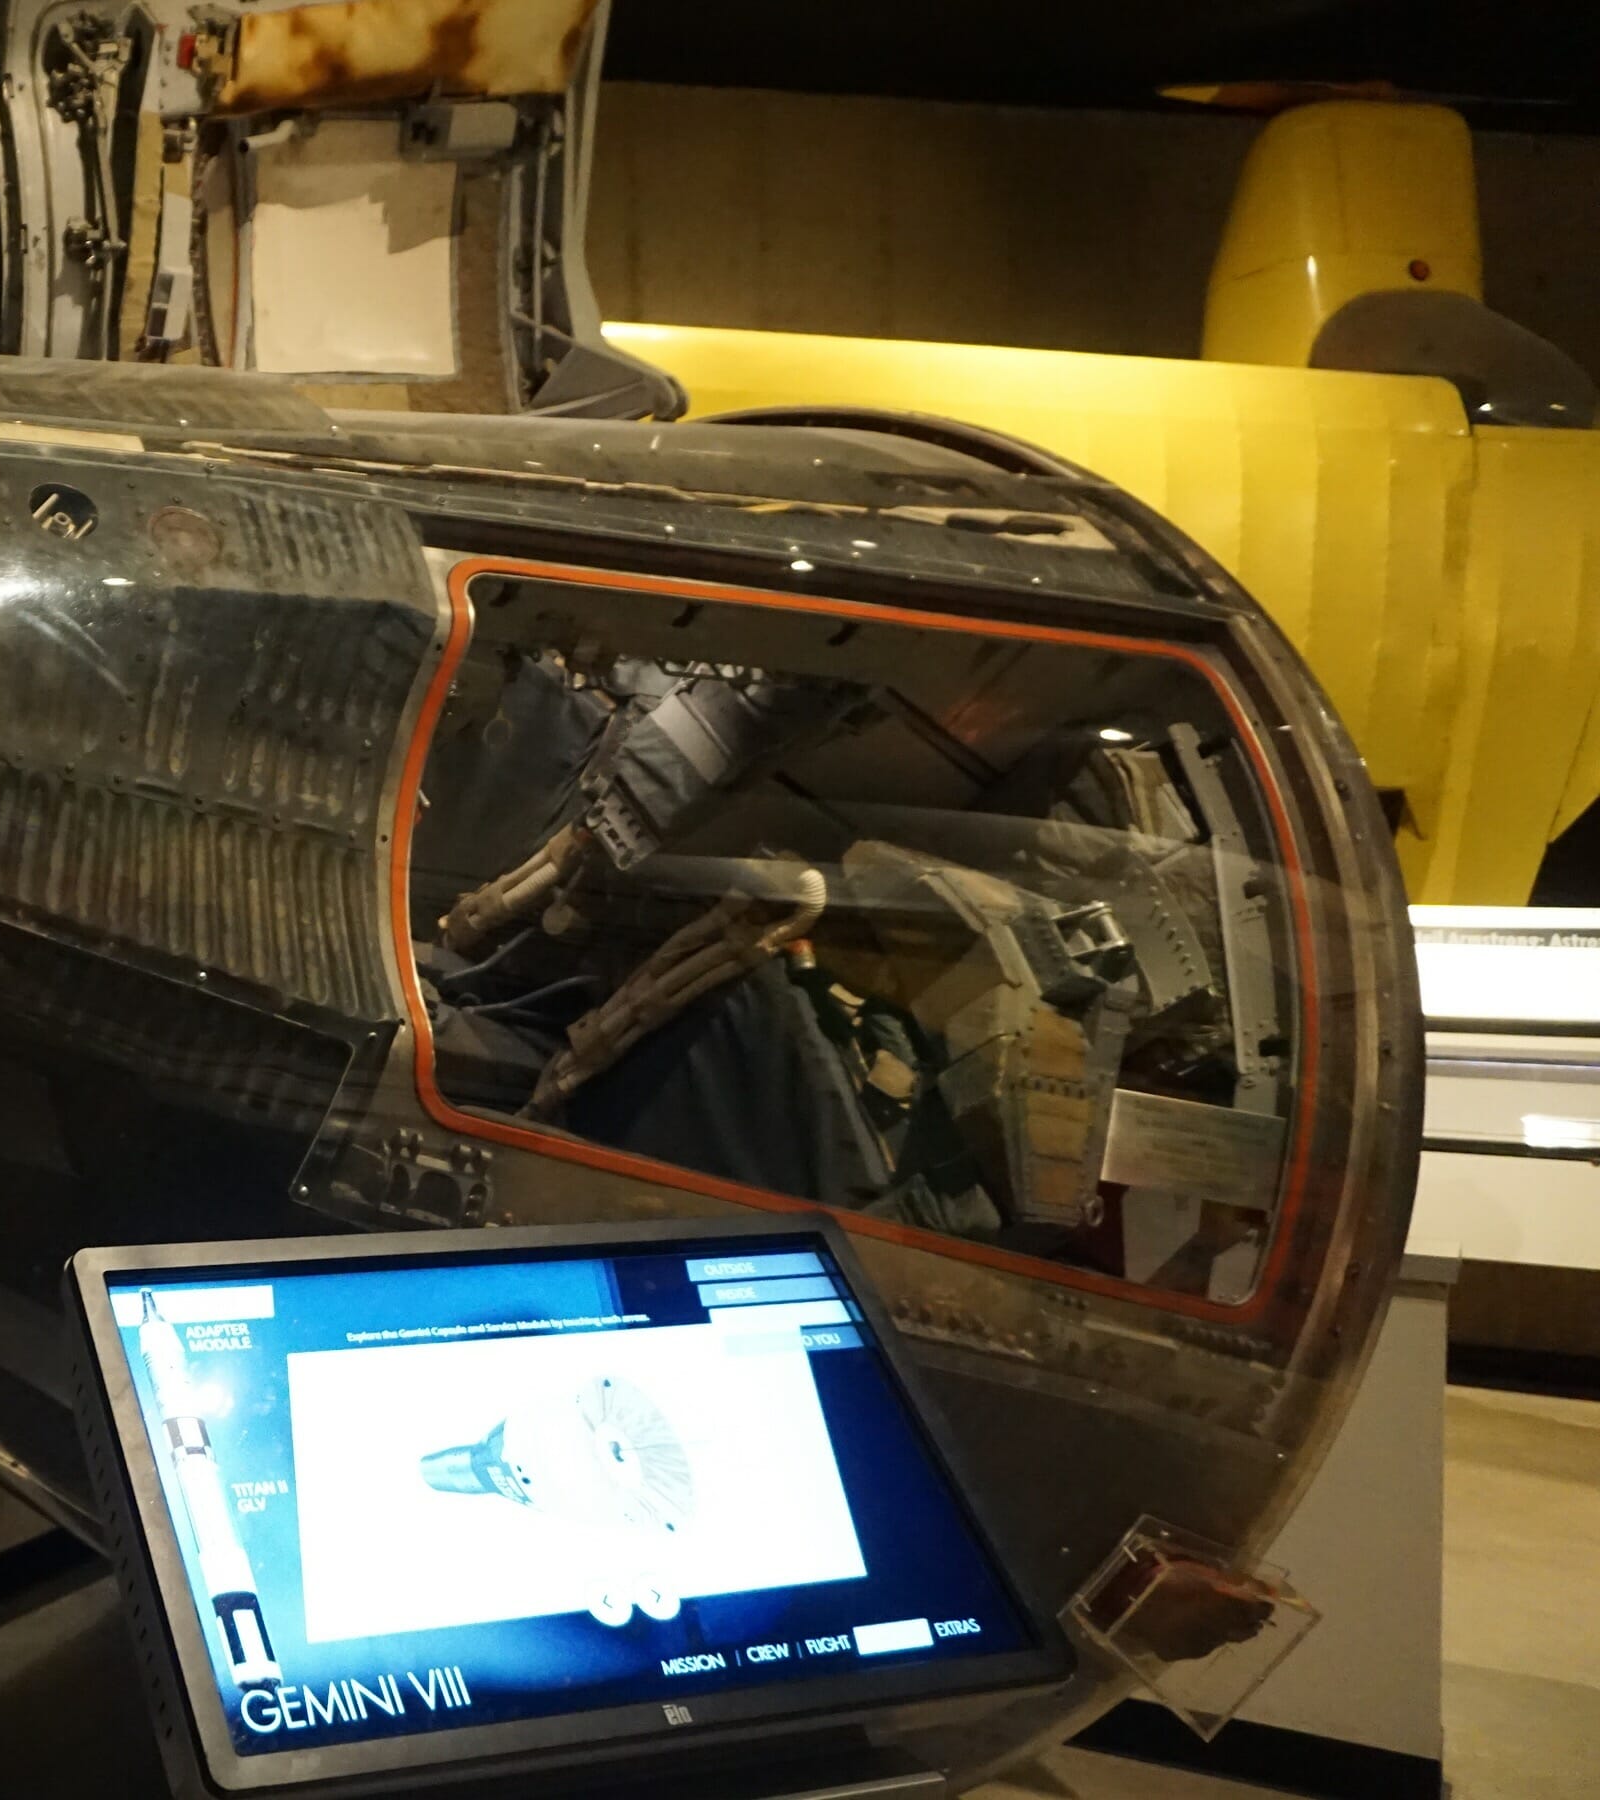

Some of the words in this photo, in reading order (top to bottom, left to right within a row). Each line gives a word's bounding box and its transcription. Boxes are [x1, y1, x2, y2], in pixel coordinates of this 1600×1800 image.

[703, 1262, 756, 1276] OUTSIDE
[715, 1286, 757, 1300] INSIDE
[185, 1323, 250, 1338] ADAPTER
[382, 1330, 398, 1339] the
[399, 1328, 431, 1338] Gemini
[468, 1324, 485, 1333] and
[517, 1320, 551, 1329] Module
[550, 1319, 563, 1329] by
[189, 1336, 252, 1353] MODULE
[813, 1333, 841, 1345] YOU
[231, 1480, 277, 1498] TITAN
[276, 1479, 289, 1494] II
[237, 1496, 267, 1513] GLV
[661, 1653, 726, 1676] MISSION
[746, 1643, 789, 1663] CREW
[804, 1634, 851, 1655] FLIGHT
[933, 1618, 981, 1638] EXTRAS
[240, 1673, 406, 1734] GEMINI
[406, 1666, 471, 1711] VIII
